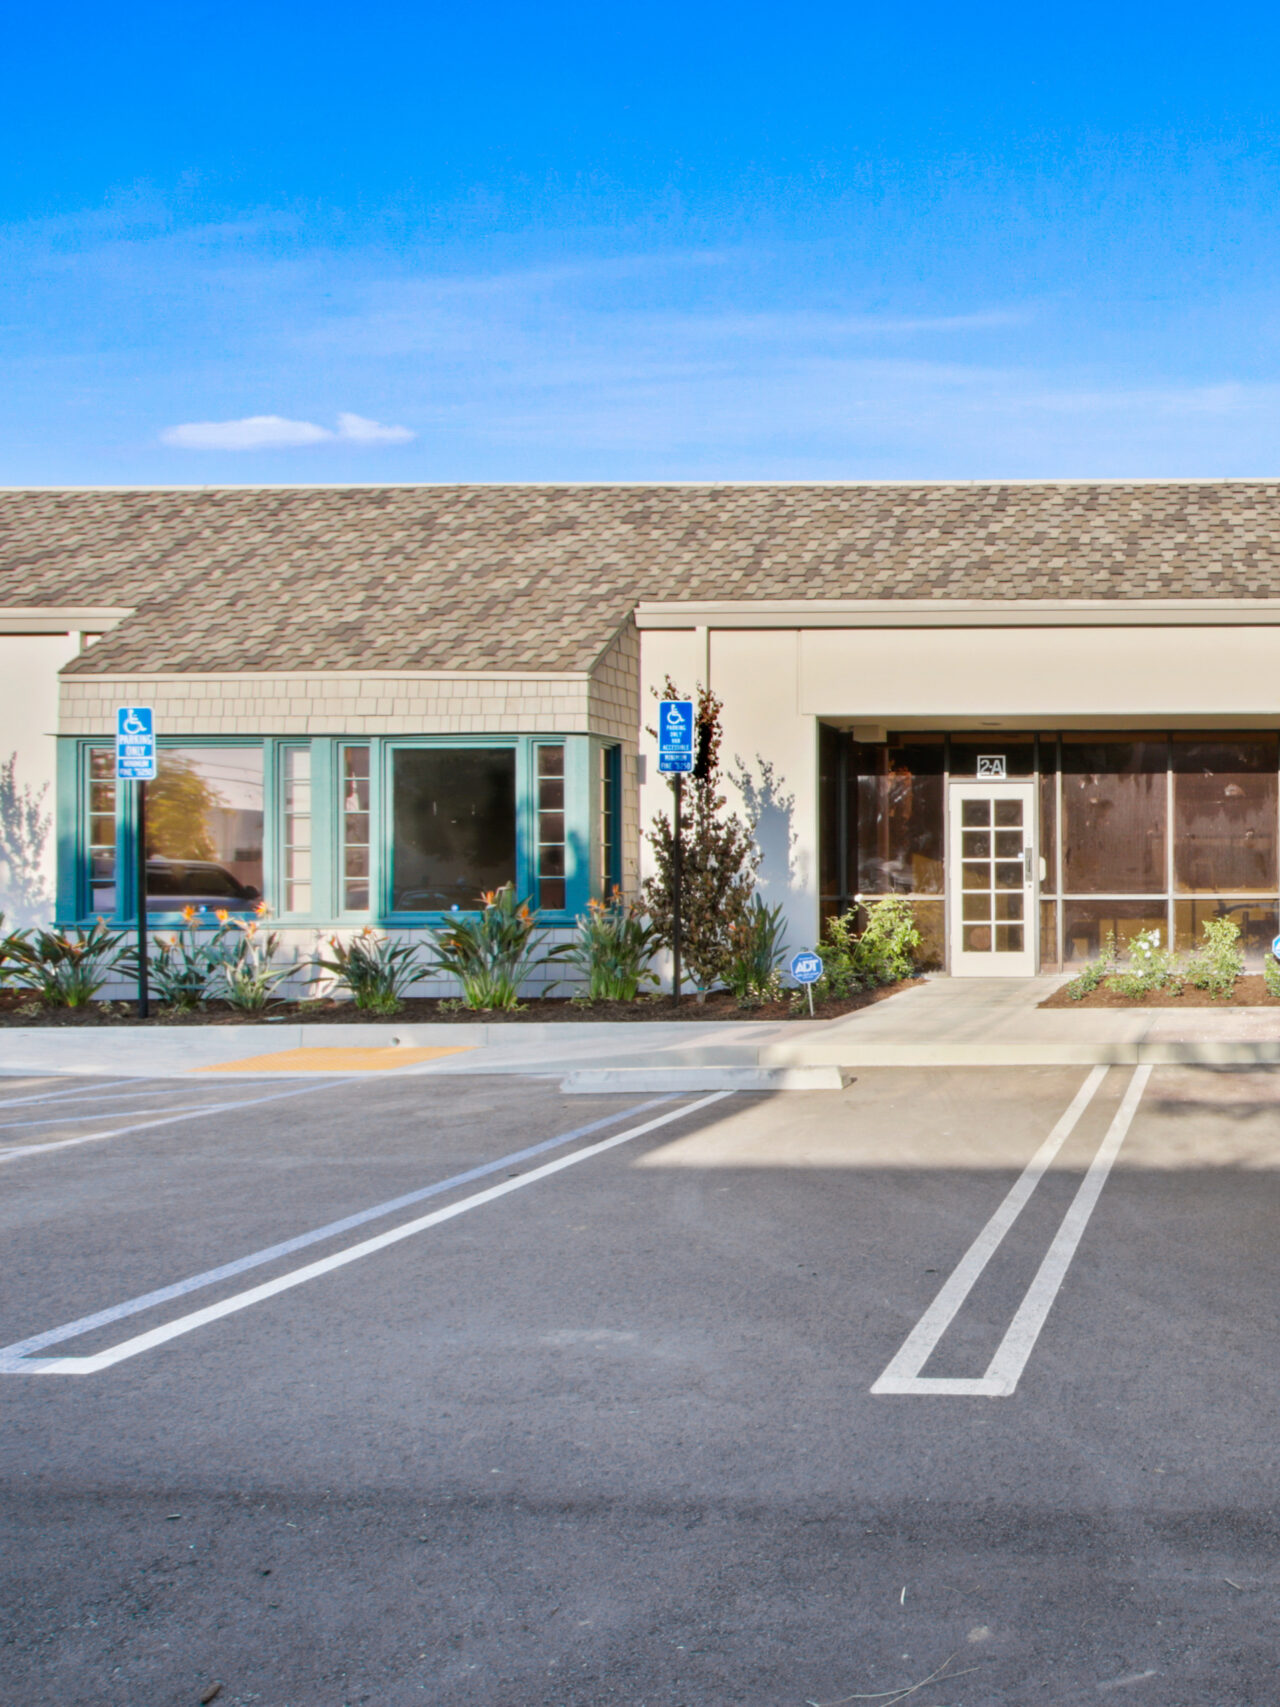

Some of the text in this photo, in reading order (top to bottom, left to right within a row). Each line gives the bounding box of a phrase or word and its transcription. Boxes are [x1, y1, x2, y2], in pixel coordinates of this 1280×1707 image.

[119, 734, 152, 745] PARKING
[124, 745, 146, 756] ONLY
[795, 959, 819, 974] ADT
